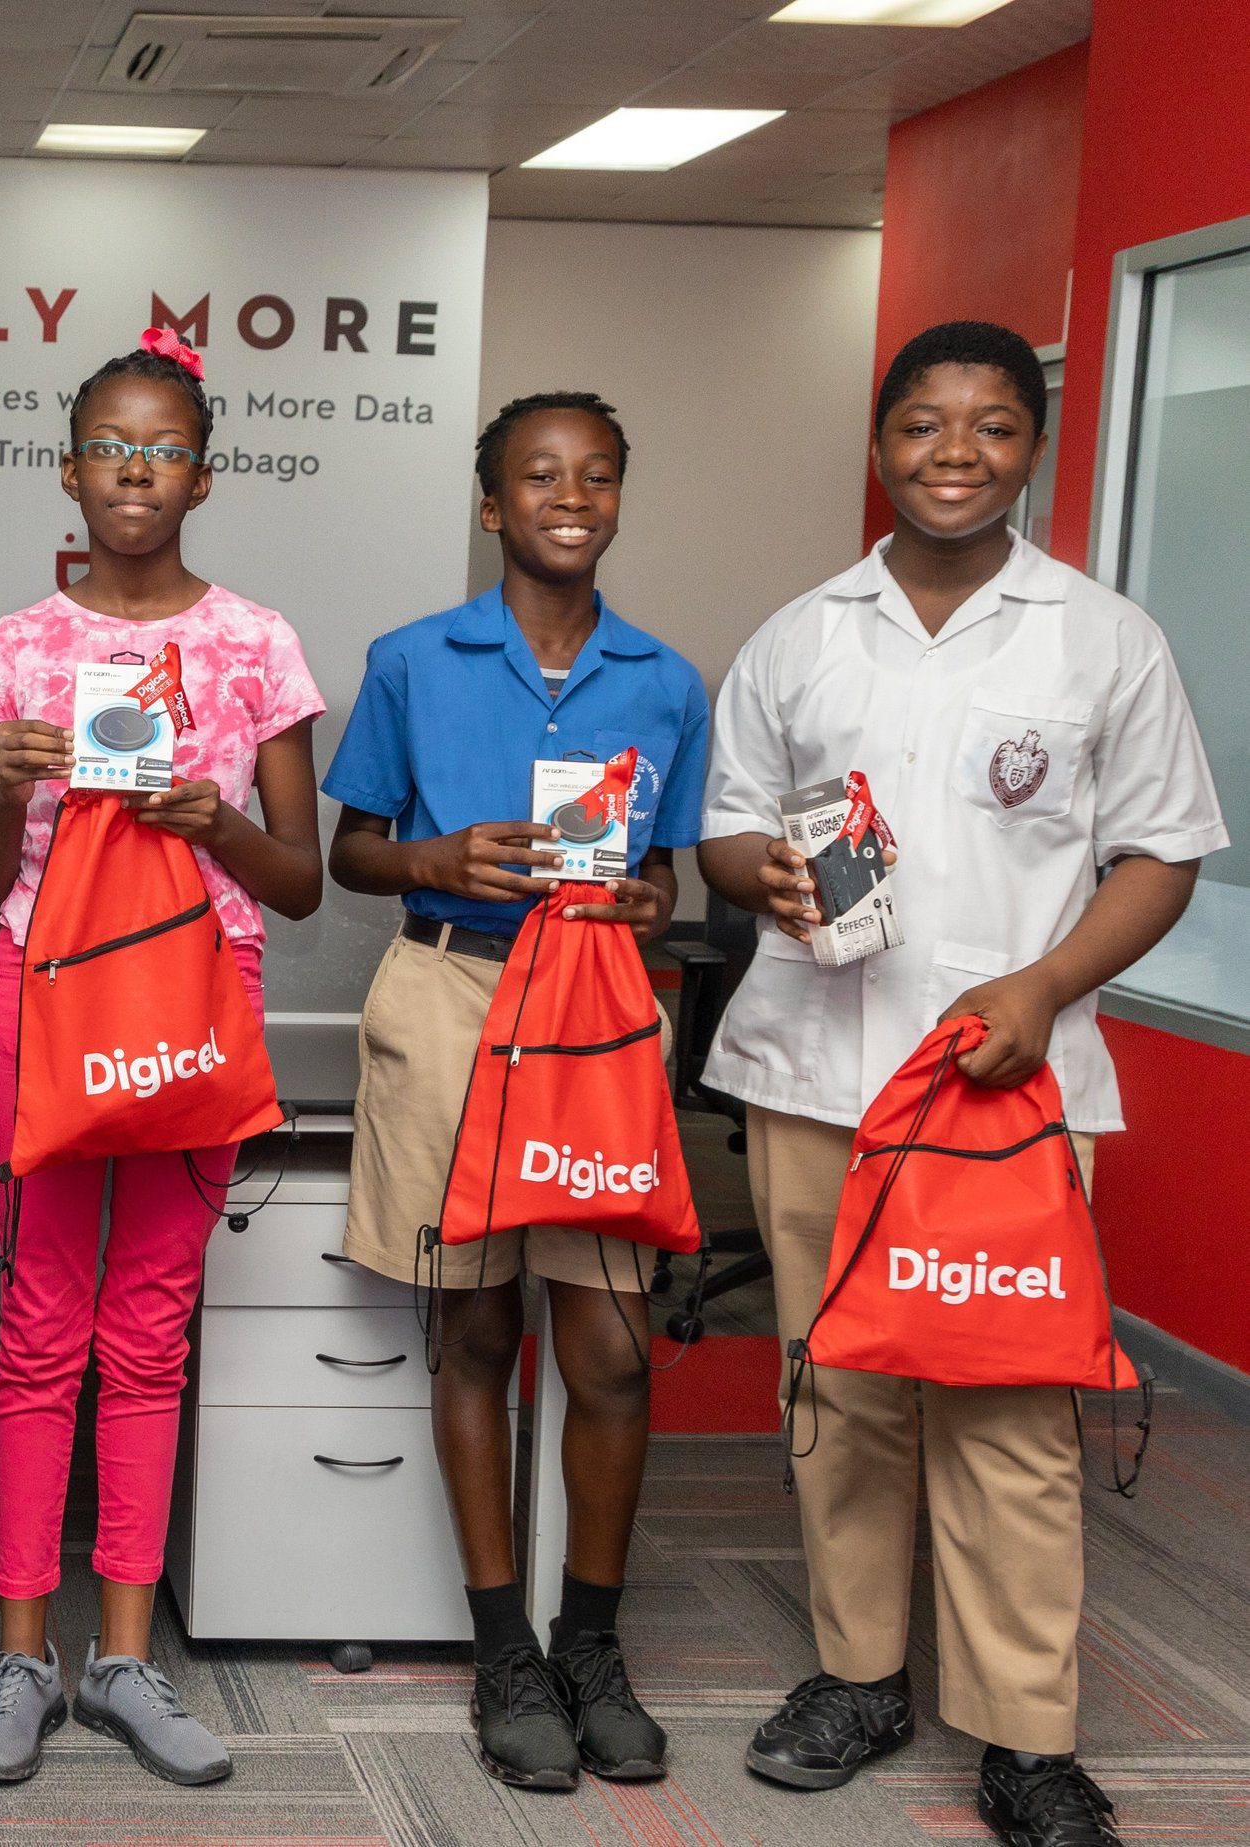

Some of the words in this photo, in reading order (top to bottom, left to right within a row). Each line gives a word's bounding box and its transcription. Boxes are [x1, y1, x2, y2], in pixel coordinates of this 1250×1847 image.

[150, 290, 439, 356] MORE
[247, 390, 336, 420] More
[355, 393, 434, 424] Data
[205, 445, 320, 482] obago
[136, 669, 168, 698] Digicel
[174, 691, 191, 727] Digicel
[808, 813, 846, 832] ULTIMATE
[810, 822, 841, 839] SOUND
[846, 800, 866, 833] Digicel
[837, 914, 875, 934] EFFECTS
[83, 1026, 227, 1098] Digicel
[520, 1139, 660, 1200] Digicel
[888, 1246, 1066, 1305] Digicel
